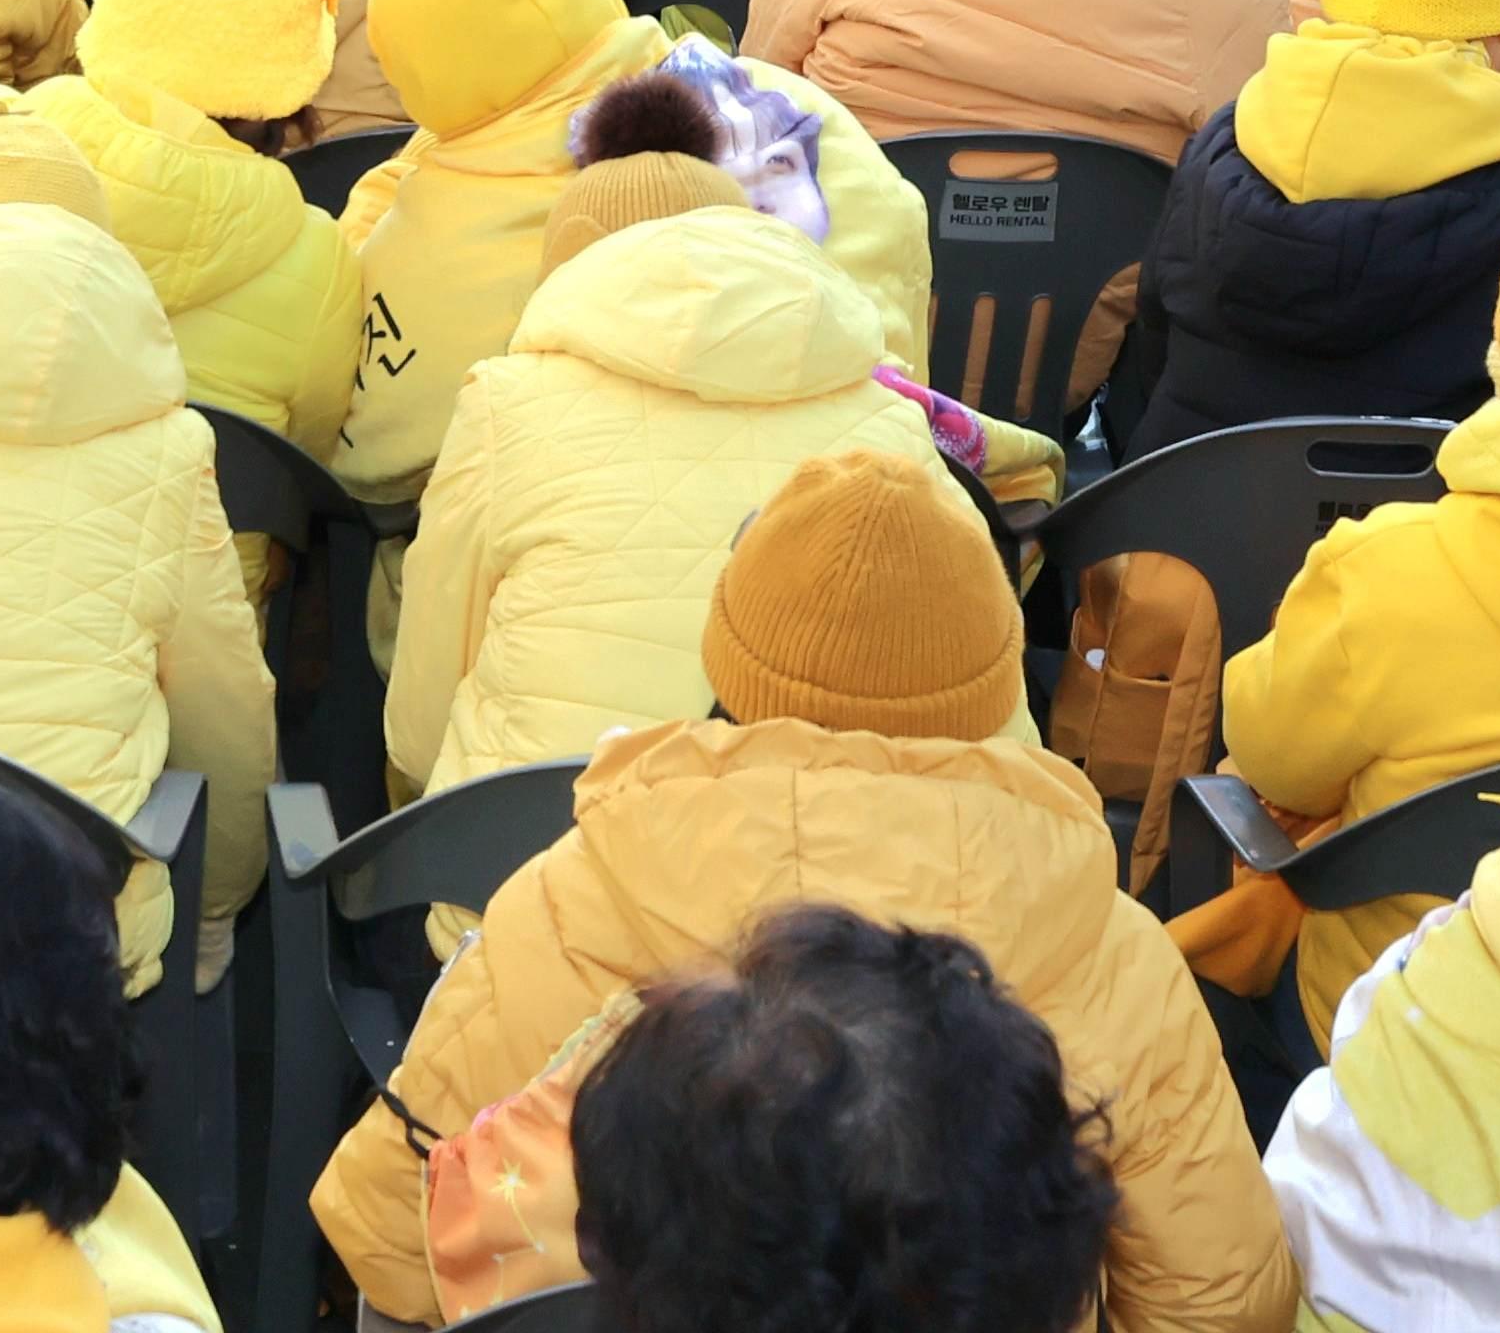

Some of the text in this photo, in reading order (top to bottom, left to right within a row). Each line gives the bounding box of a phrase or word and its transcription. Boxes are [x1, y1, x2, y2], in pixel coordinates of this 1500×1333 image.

[953, 194, 1050, 212] 헬로우 렌탈
[950, 214, 1047, 227] HELLO RENTAL
